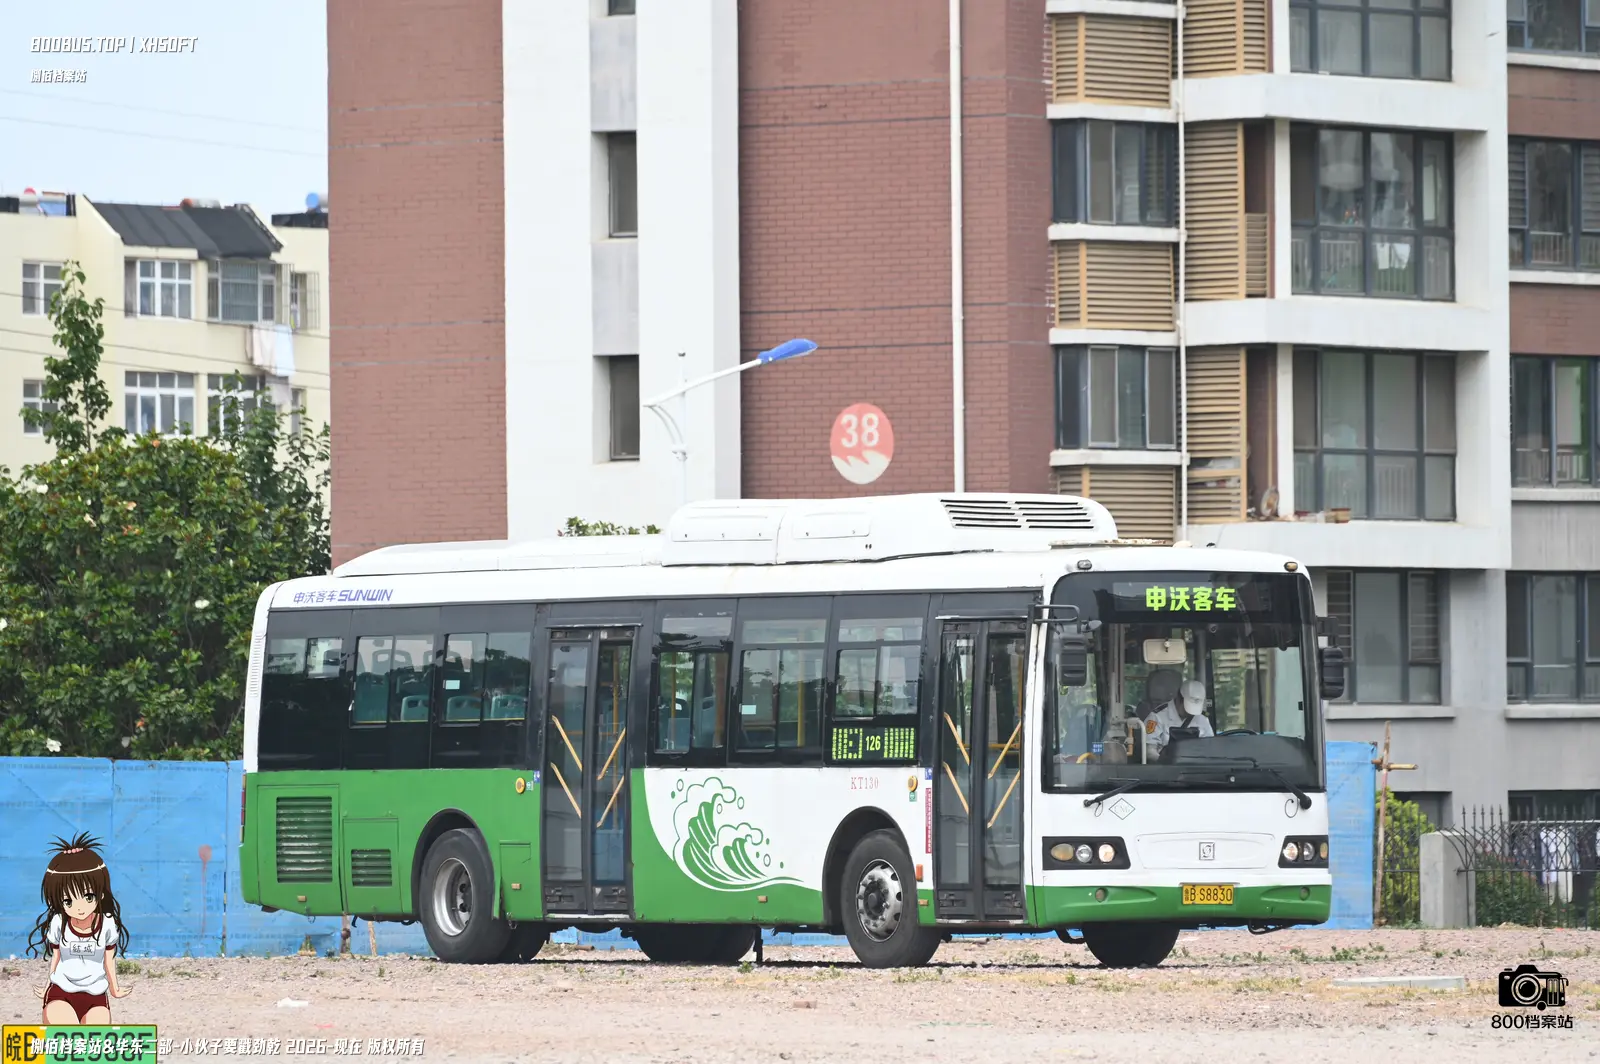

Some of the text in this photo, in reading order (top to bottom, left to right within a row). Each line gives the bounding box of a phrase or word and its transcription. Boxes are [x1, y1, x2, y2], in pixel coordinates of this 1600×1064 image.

[841, 412, 879, 448] 38
[294, 589, 393, 604] 申沃客车 SUNWIN
[1145, 585, 1237, 611] 申沃客车
[865, 735, 881, 751] 126
[850, 776, 879, 790] KT130
